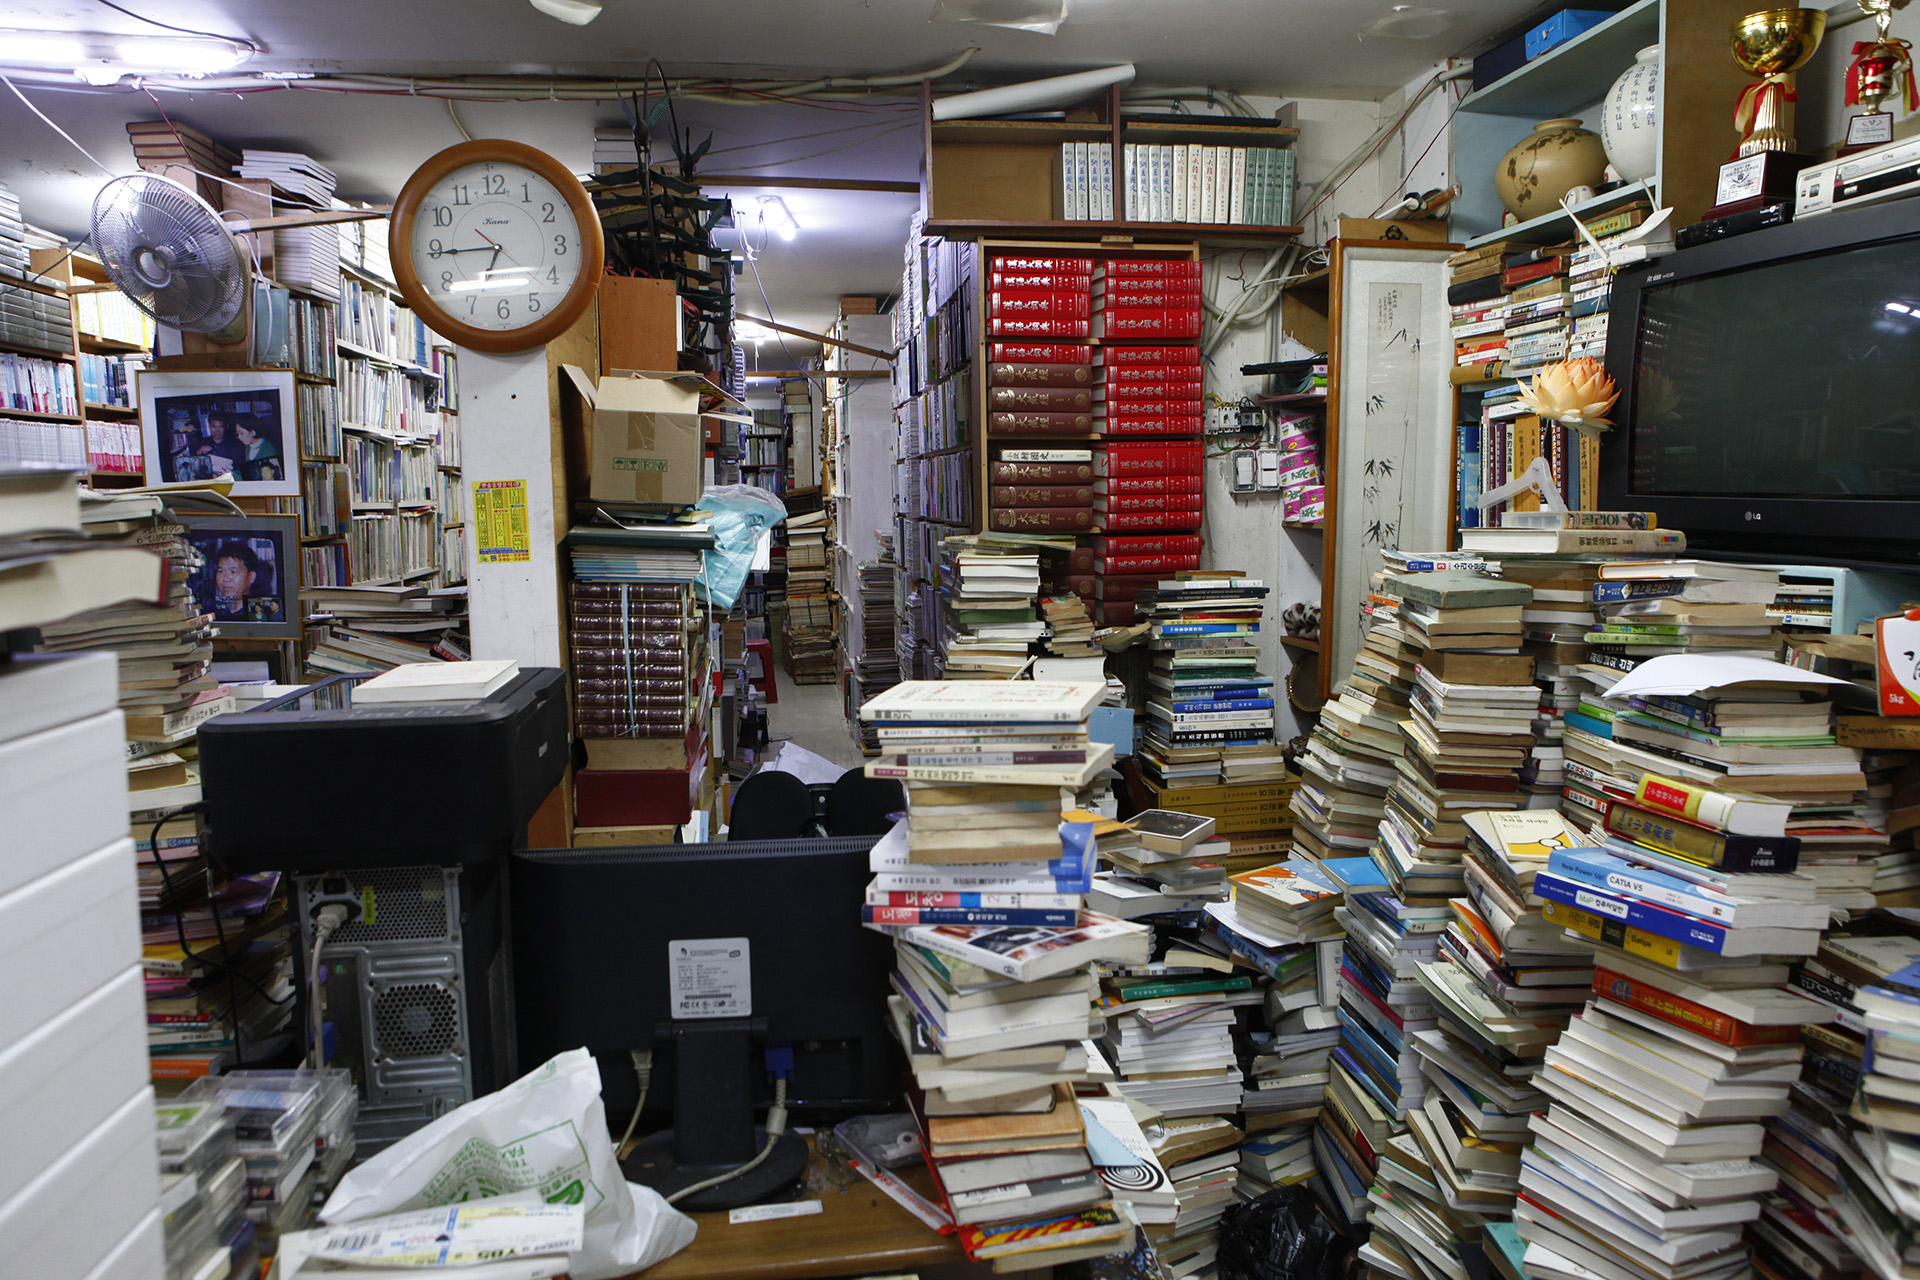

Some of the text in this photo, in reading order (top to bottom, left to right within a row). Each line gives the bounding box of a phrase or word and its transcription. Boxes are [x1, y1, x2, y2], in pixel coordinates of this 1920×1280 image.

[452, 185, 471, 205] 11
[483, 175, 506, 196] 12
[521, 183, 532, 203] 1
[432, 206, 452, 227] 10
[542, 203, 555, 223] 2
[429, 239, 442, 259] 9
[554, 235, 567, 255] 3
[441, 271, 453, 291] 8
[546, 265, 559, 285] 4
[466, 295, 478, 315] 7
[497, 299, 510, 319] 6
[528, 292, 541, 312] 5
[1889, 694, 1904, 704] 5kg
[1561, 863, 1575, 872] New
[1575, 866, 1594, 877] Power
[1609, 875, 1643, 892] CATIA V5
[1631, 934, 1653, 948] Europe
